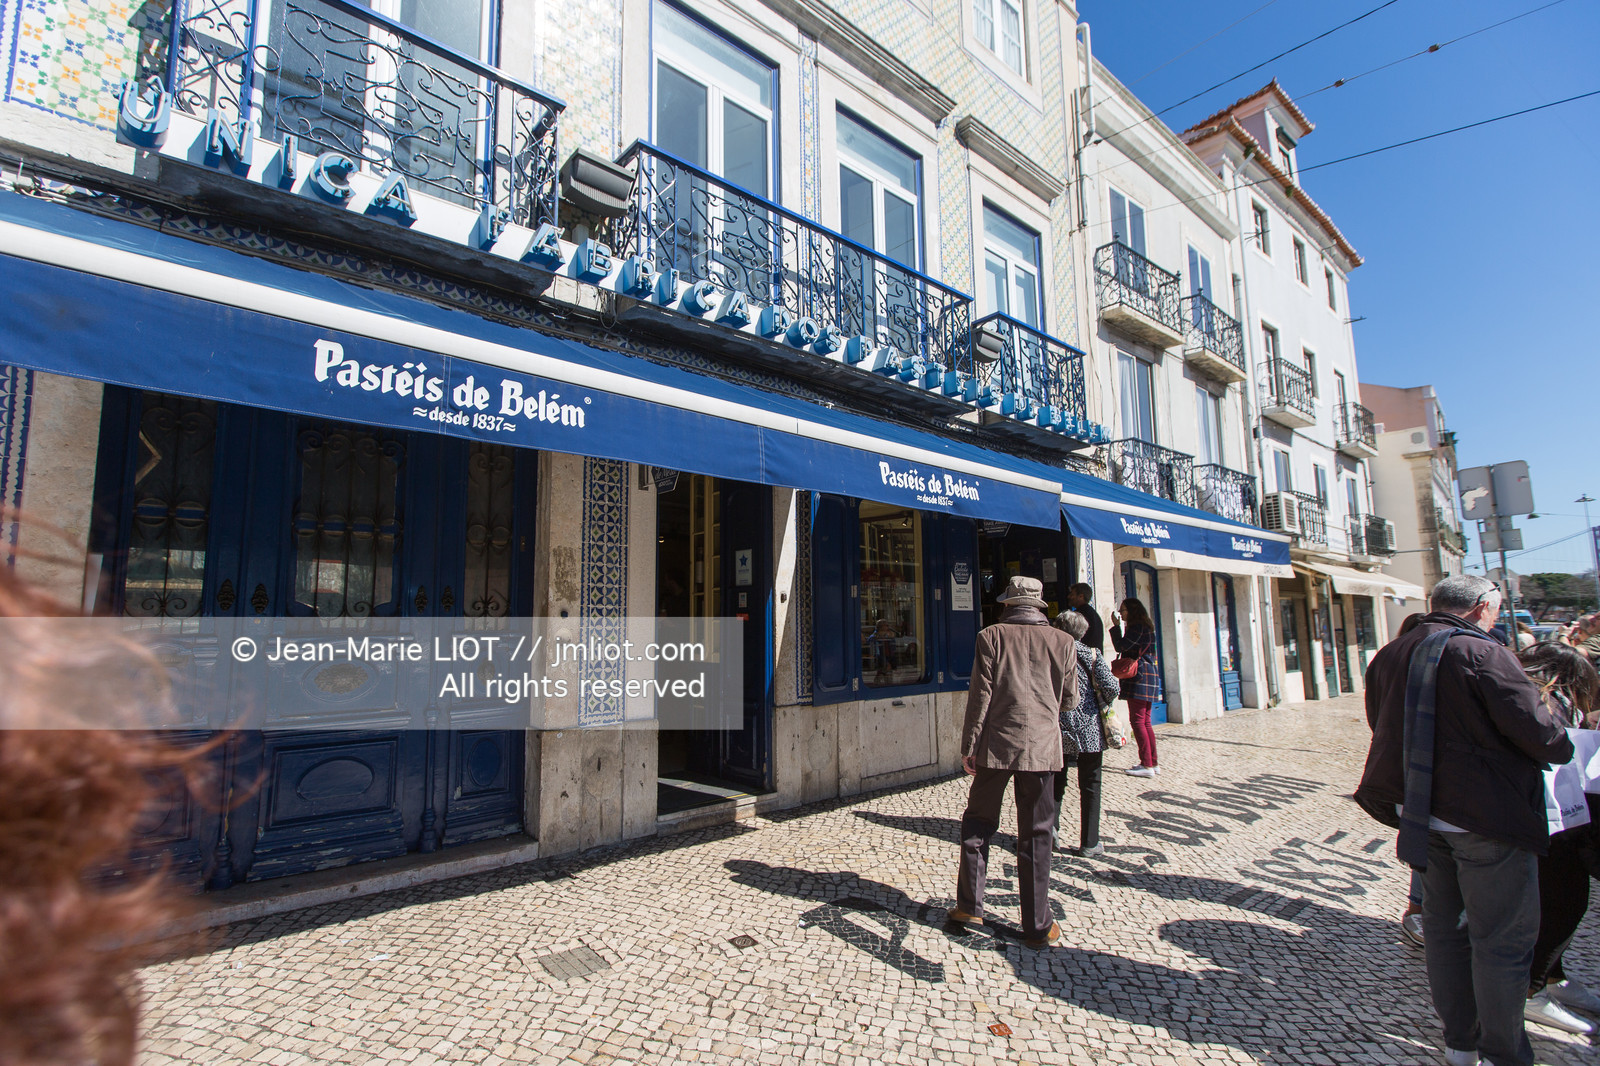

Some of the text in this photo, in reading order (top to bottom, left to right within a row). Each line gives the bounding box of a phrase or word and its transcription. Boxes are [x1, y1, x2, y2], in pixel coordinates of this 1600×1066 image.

[761, 304, 842, 354] DOS
[313, 338, 444, 402] Pastéis
[453, 375, 490, 410] de
[429, 406, 504, 432] desde 1837
[922, 494, 938, 505] desde
[928, 473, 942, 494] de
[1136, 773, 1329, 825] Belém
[1104, 809, 1230, 847] de
[1234, 836, 1393, 908] 1837
